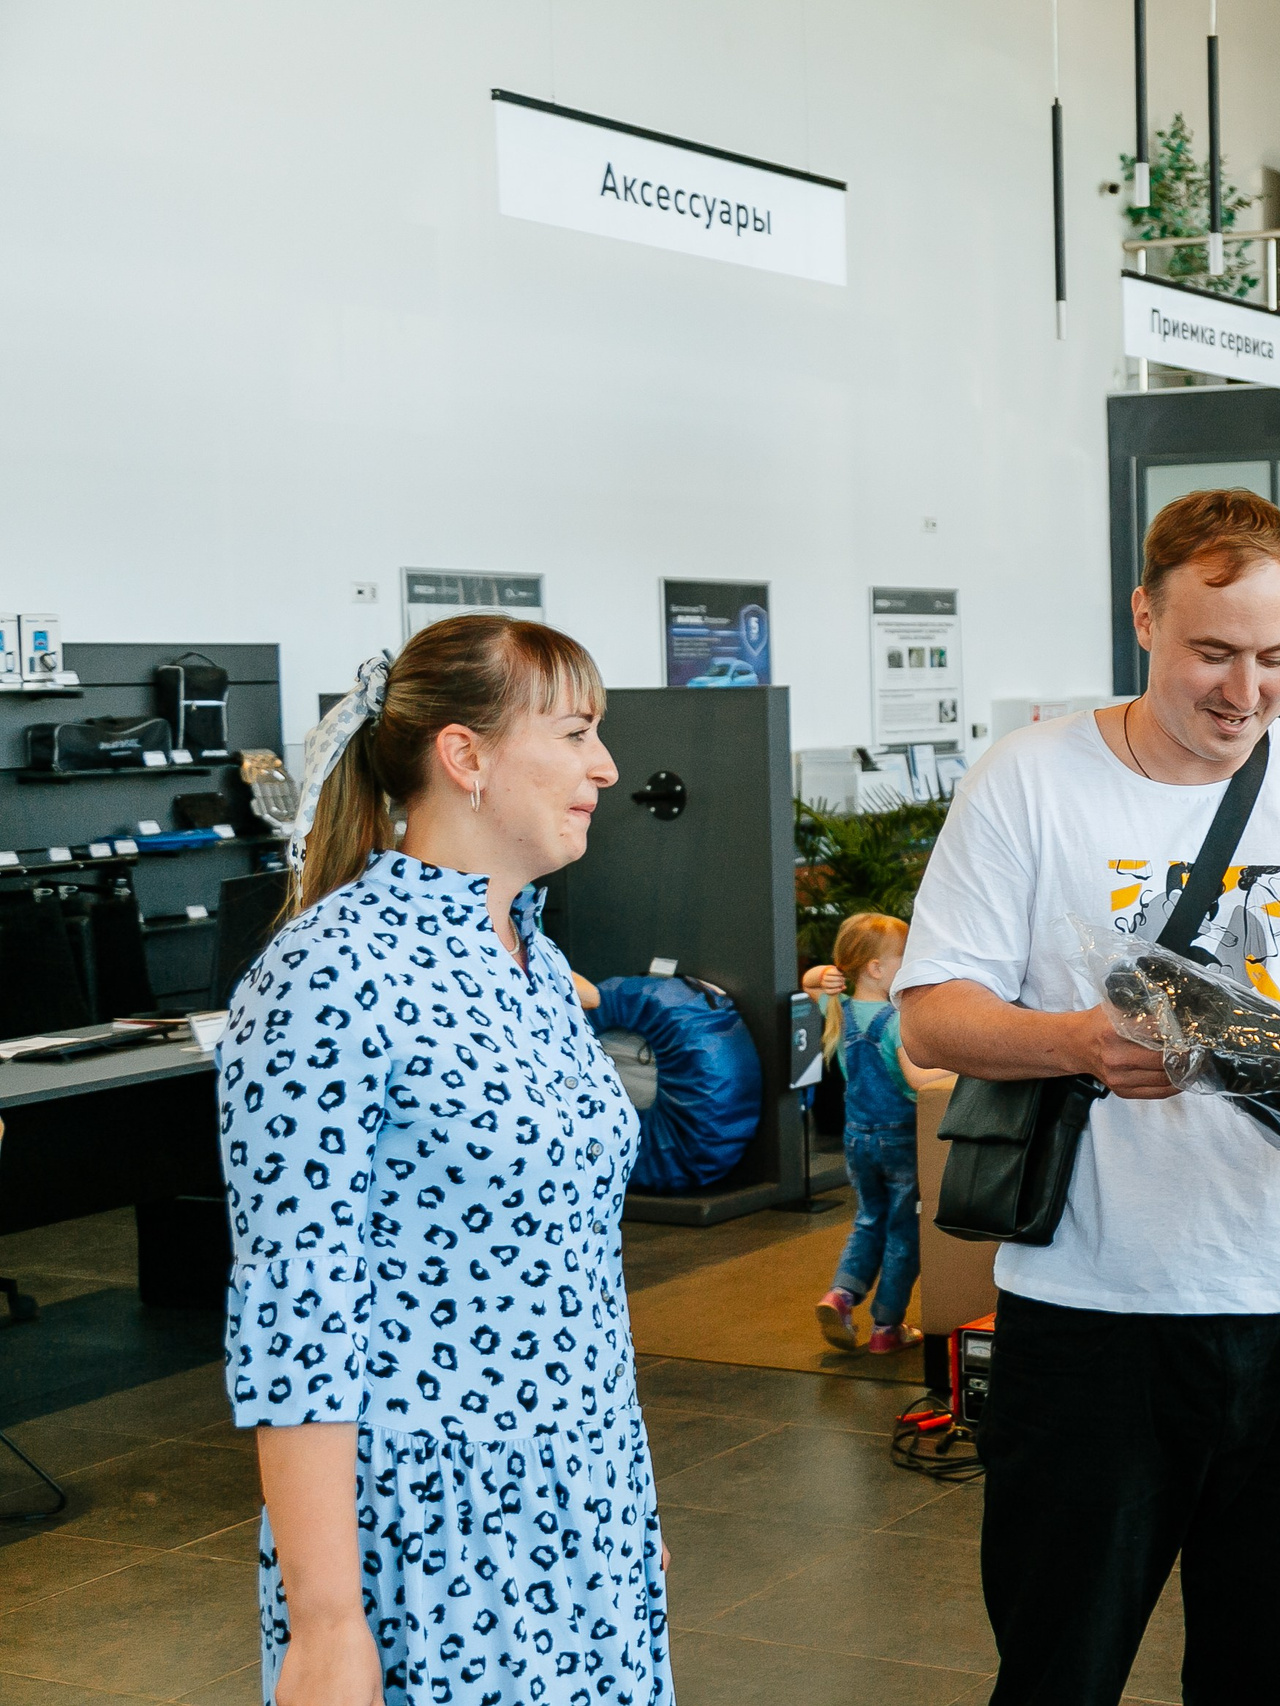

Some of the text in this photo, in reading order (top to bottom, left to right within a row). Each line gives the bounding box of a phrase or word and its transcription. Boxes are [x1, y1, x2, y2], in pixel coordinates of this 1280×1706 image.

[600, 162, 772, 237] Аксессуары
[1151, 307, 1275, 359] Приемка сервиса
